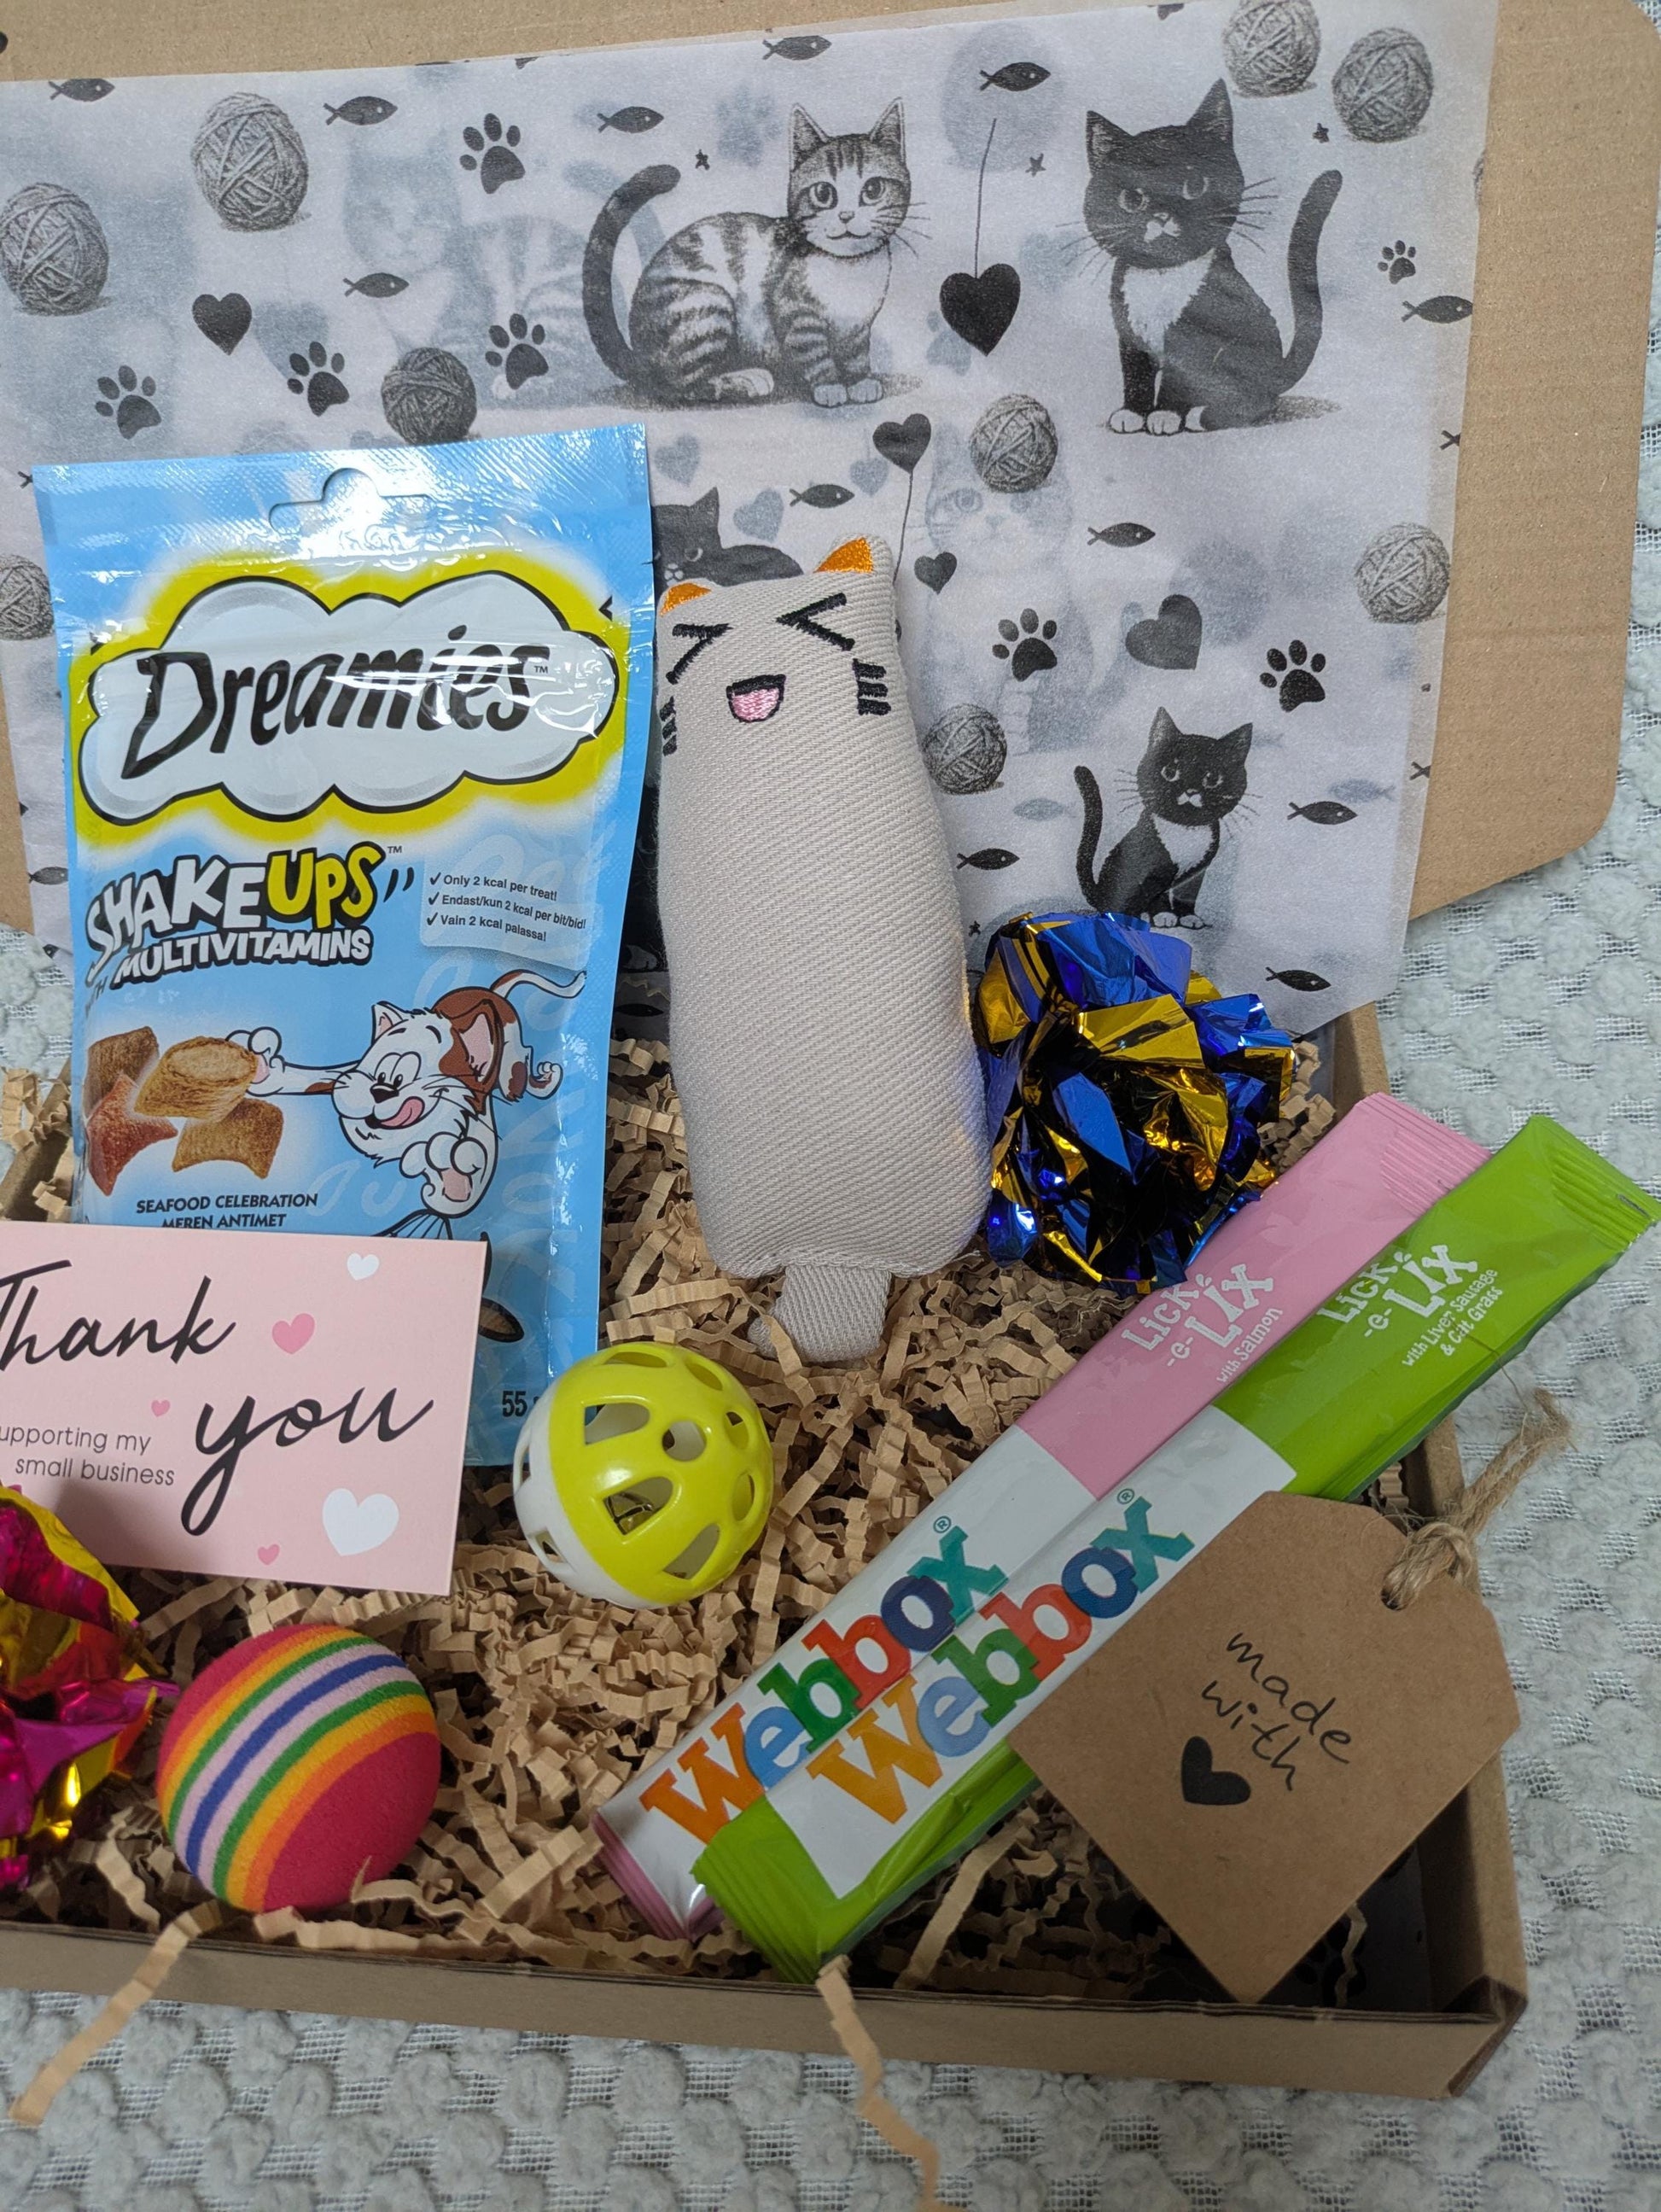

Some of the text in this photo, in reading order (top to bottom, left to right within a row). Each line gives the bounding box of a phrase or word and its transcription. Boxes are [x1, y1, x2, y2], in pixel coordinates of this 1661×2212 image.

[120, 625, 551, 779] Dreamies
[442, 895, 586, 930] Endast/kun 2 kcal per bit/bid!
[443, 875, 557, 902] Only 2 kcal per treat!
[110, 928, 373, 989] MULTIVITAMINS
[440, 914, 546, 942] Vain 2 kcal palassa!
[137, 1194, 318, 1213] SEAFOOD CELEBRATION
[217, 1214, 287, 1228] ANTIMET
[1216, 1306, 1284, 1383] with Salmon
[1402, 1269, 1498, 1367] with Liver Sausage
[1440, 1286, 1503, 1356] & Cat Grass
[501, 1390, 528, 1417] 55
[0, 1426, 151, 1456] upporting my
[15, 1456, 175, 1486] small business
[180, 1386, 434, 1536] you
[638, 1525, 1009, 1847] Webbox
[805, 1496, 1196, 1824] Webbox
[1227, 1631, 1352, 1765] made
[1201, 1679, 1301, 1792] with
